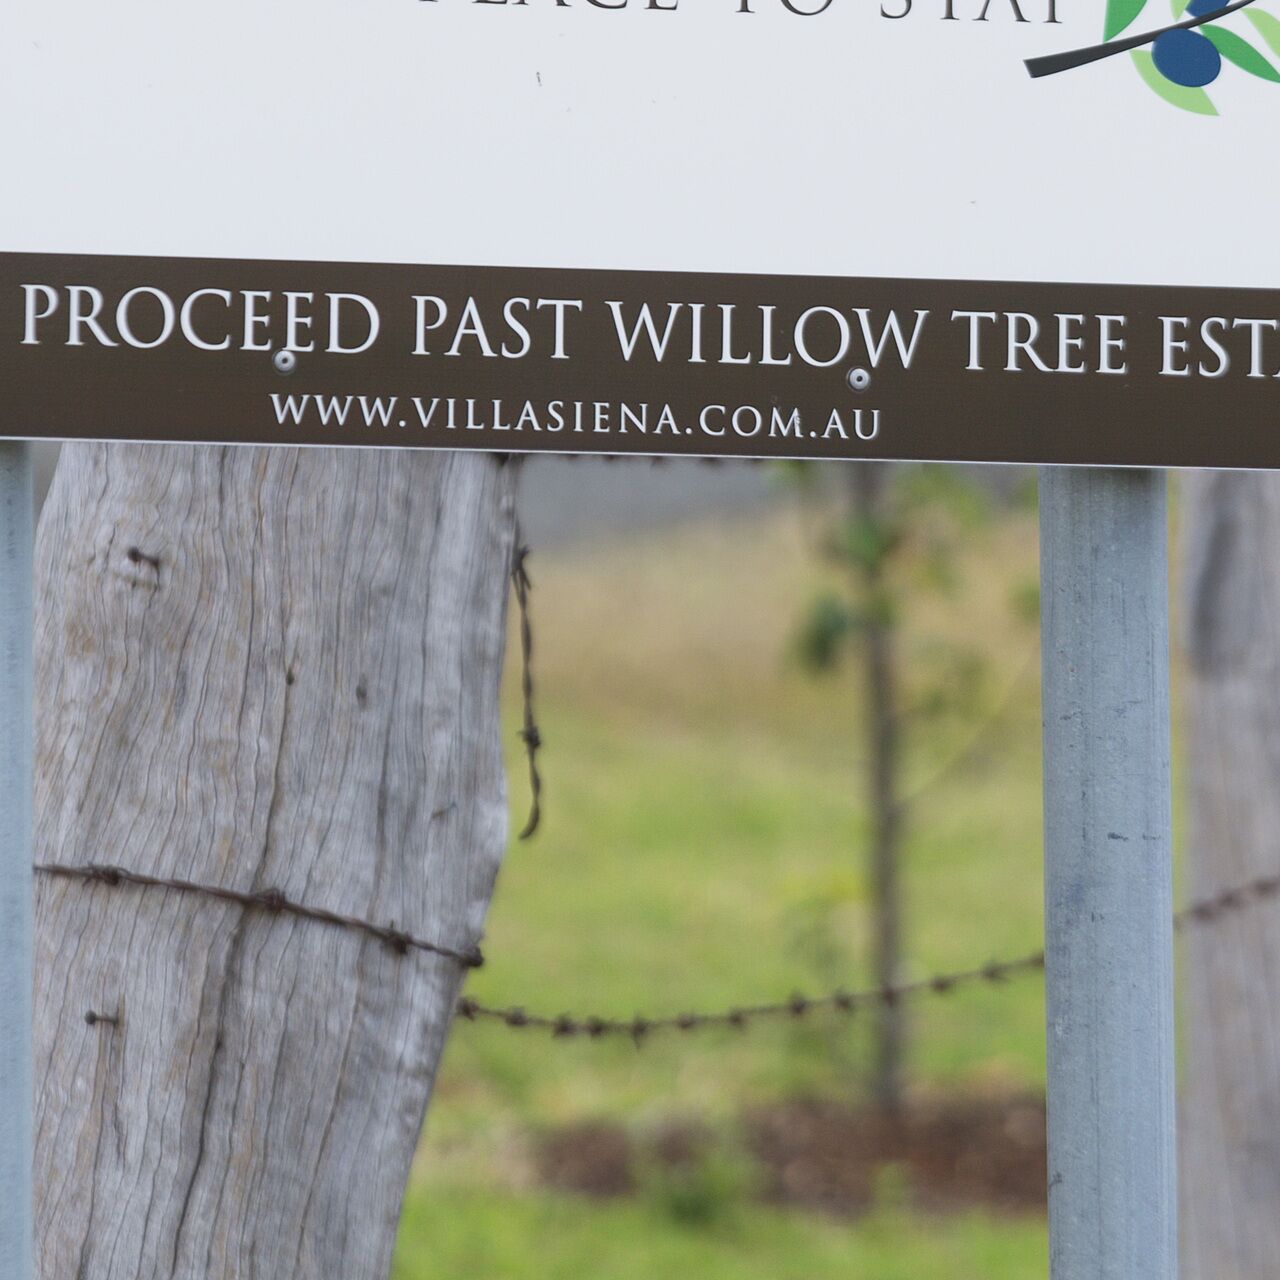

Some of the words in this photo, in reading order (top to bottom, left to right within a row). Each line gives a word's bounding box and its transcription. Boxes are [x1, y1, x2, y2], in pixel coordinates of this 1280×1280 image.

[20, 284, 381, 355] PROCEED
[411, 295, 583, 360] PAST
[604, 300, 930, 370] WILLOW
[950, 310, 1126, 376] TREE
[269, 392, 881, 441] WWW.VILLASIENA.COM.AU
